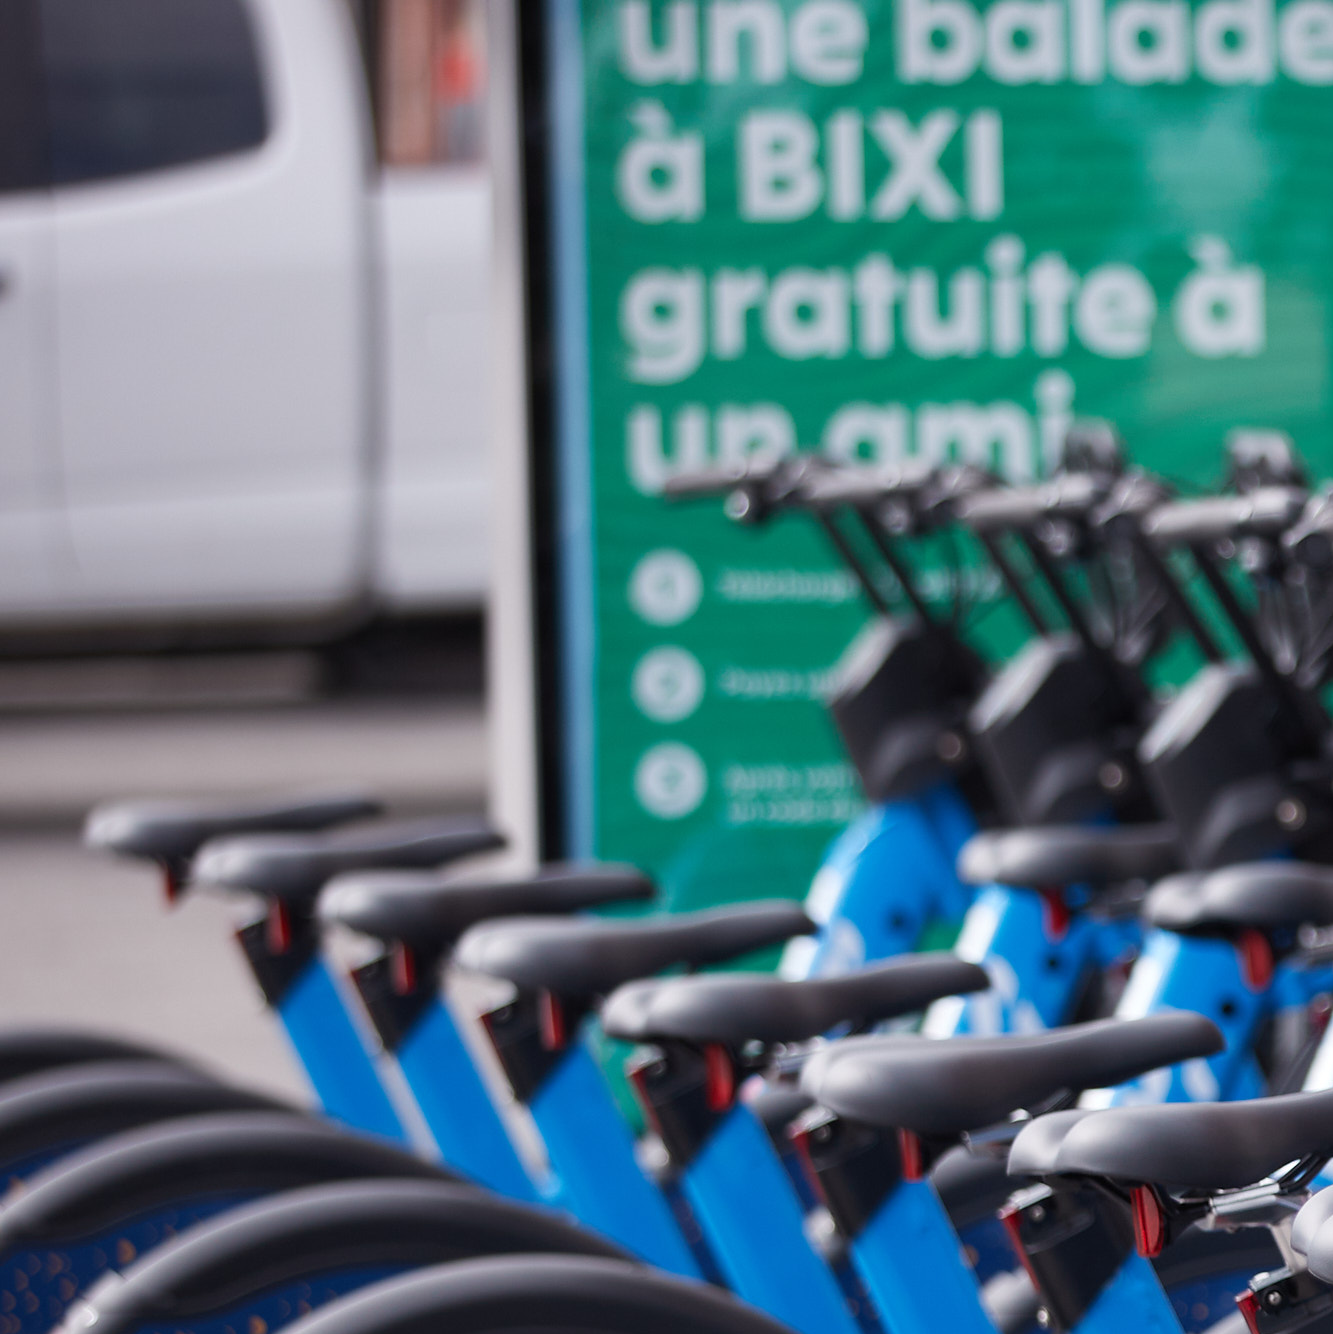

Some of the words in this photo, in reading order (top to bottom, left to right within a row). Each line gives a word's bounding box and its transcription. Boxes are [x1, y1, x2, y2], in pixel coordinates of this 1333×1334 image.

[618, 0, 868, 84] une
[616, 101, 704, 223] à
[736, 108, 1003, 222] BIXI
[621, 234, 1157, 385] gratuite
[1175, 236, 1267, 357] à
